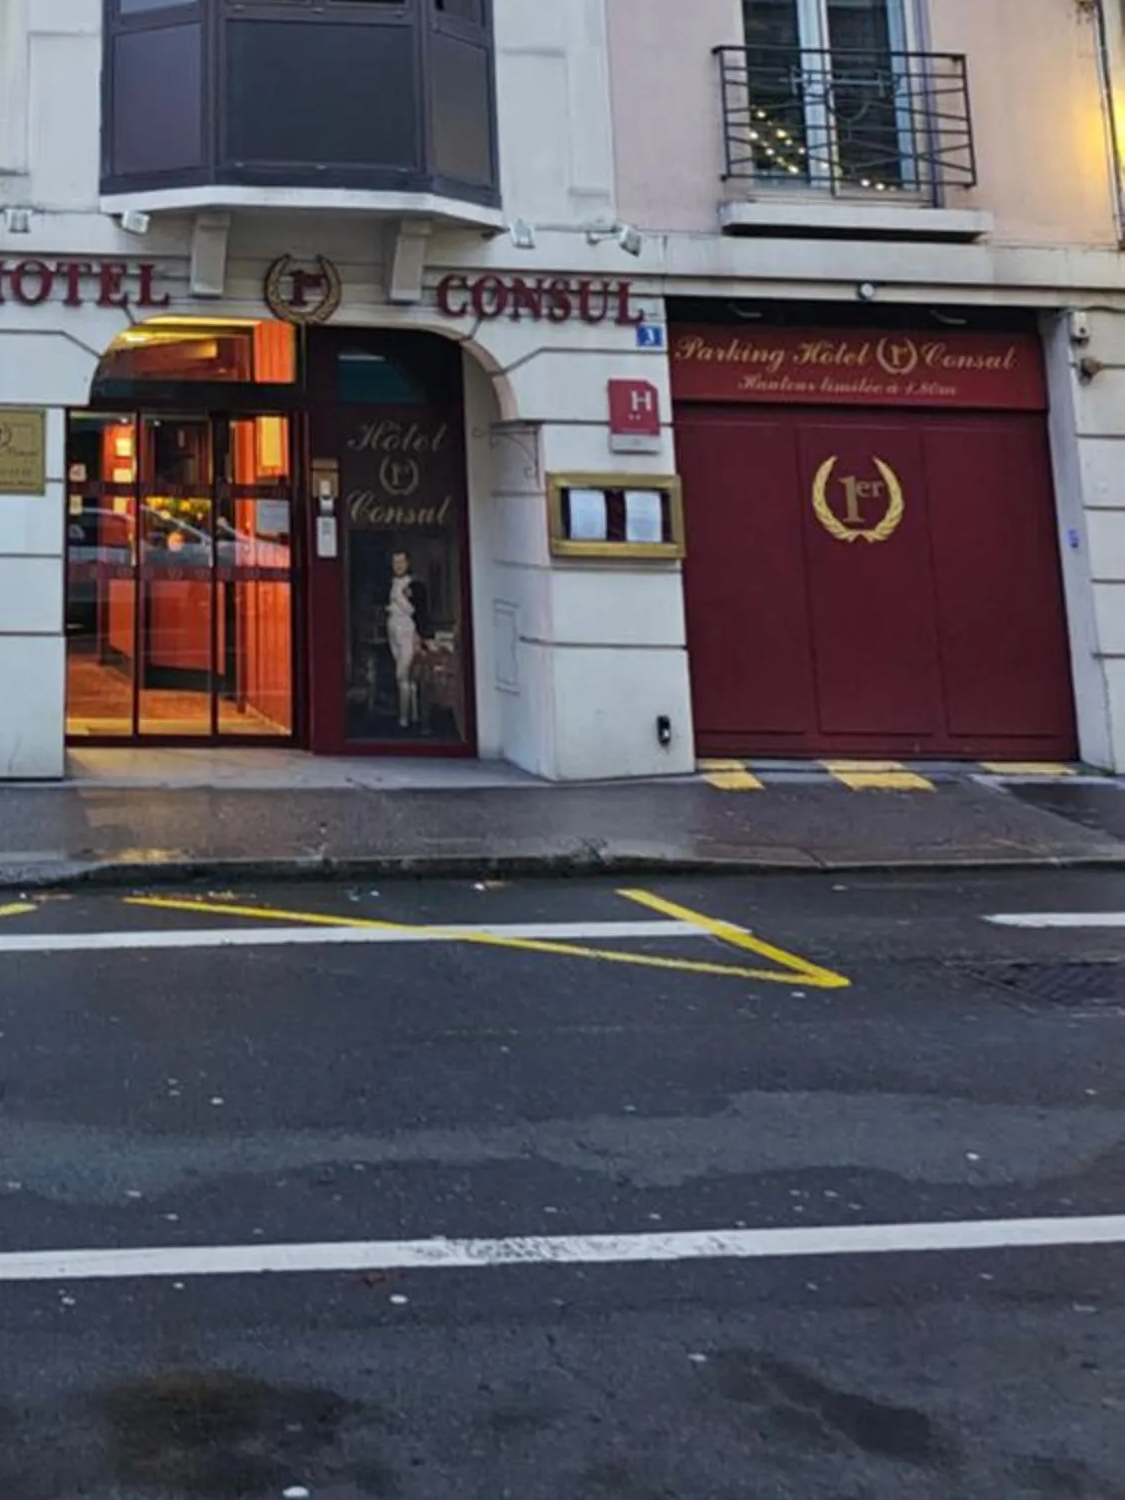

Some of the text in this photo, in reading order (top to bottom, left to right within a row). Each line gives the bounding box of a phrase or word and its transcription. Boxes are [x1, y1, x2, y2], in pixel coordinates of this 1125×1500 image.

[436, 272, 646, 326] CONSUL
[675, 334, 784, 373] Parking
[921, 340, 1019, 370] Consul
[346, 488, 453, 525] Consul
[837, 475, 885, 524] 1er
